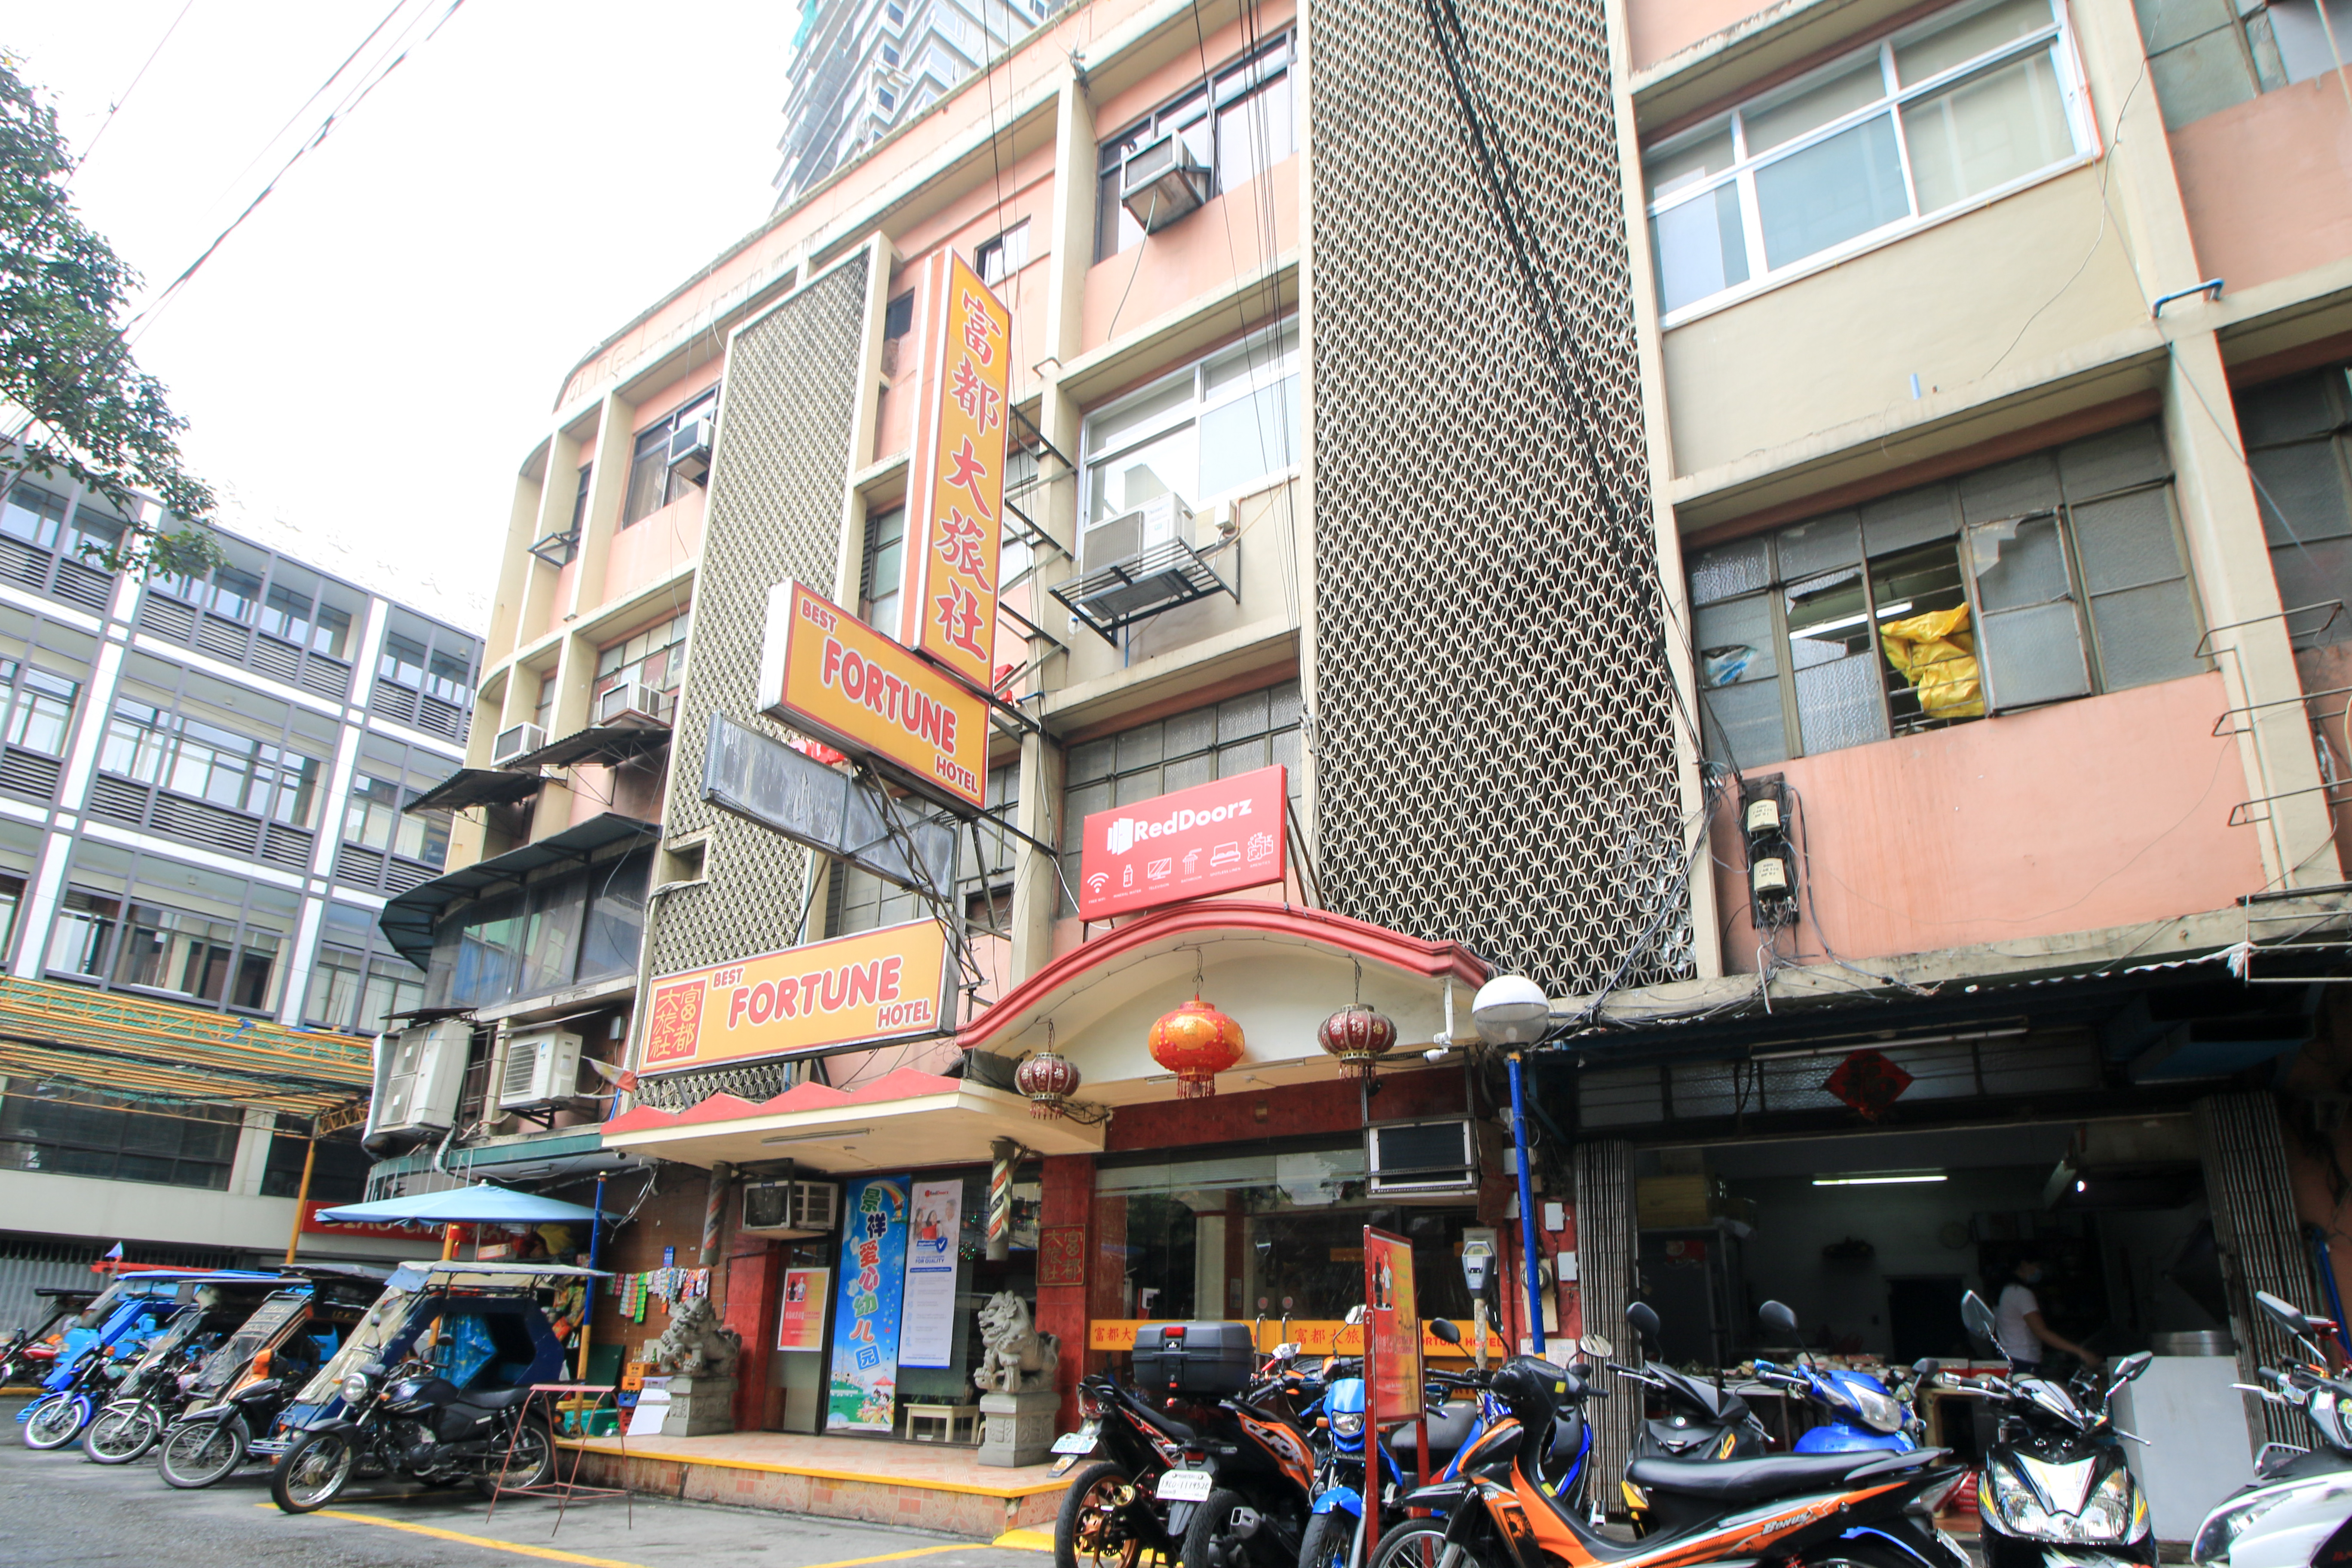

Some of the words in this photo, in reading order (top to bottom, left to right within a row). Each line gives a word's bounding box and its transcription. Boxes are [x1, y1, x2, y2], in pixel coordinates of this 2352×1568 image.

[934, 290, 1002, 662] 富都大旅社
[802, 598, 837, 633] BEST
[821, 637, 956, 754] FORTUNE
[936, 756, 978, 794] HOTEL
[1134, 799, 1252, 842] RedDoorz
[713, 967, 744, 989] BEST
[727, 956, 902, 1030] FORTUNE
[650, 989, 682, 1058] 大旅社
[876, 998, 932, 1030] HOTEL
[849, 1187, 887, 1370] 景祥爱心幼儿园
[1094, 1327, 1137, 1342] 富都大
[1295, 1328, 1363, 1344] 富都大旅
[1244, 1418, 1301, 1464] CLICK
[1484, 1490, 1499, 1501] SYM
